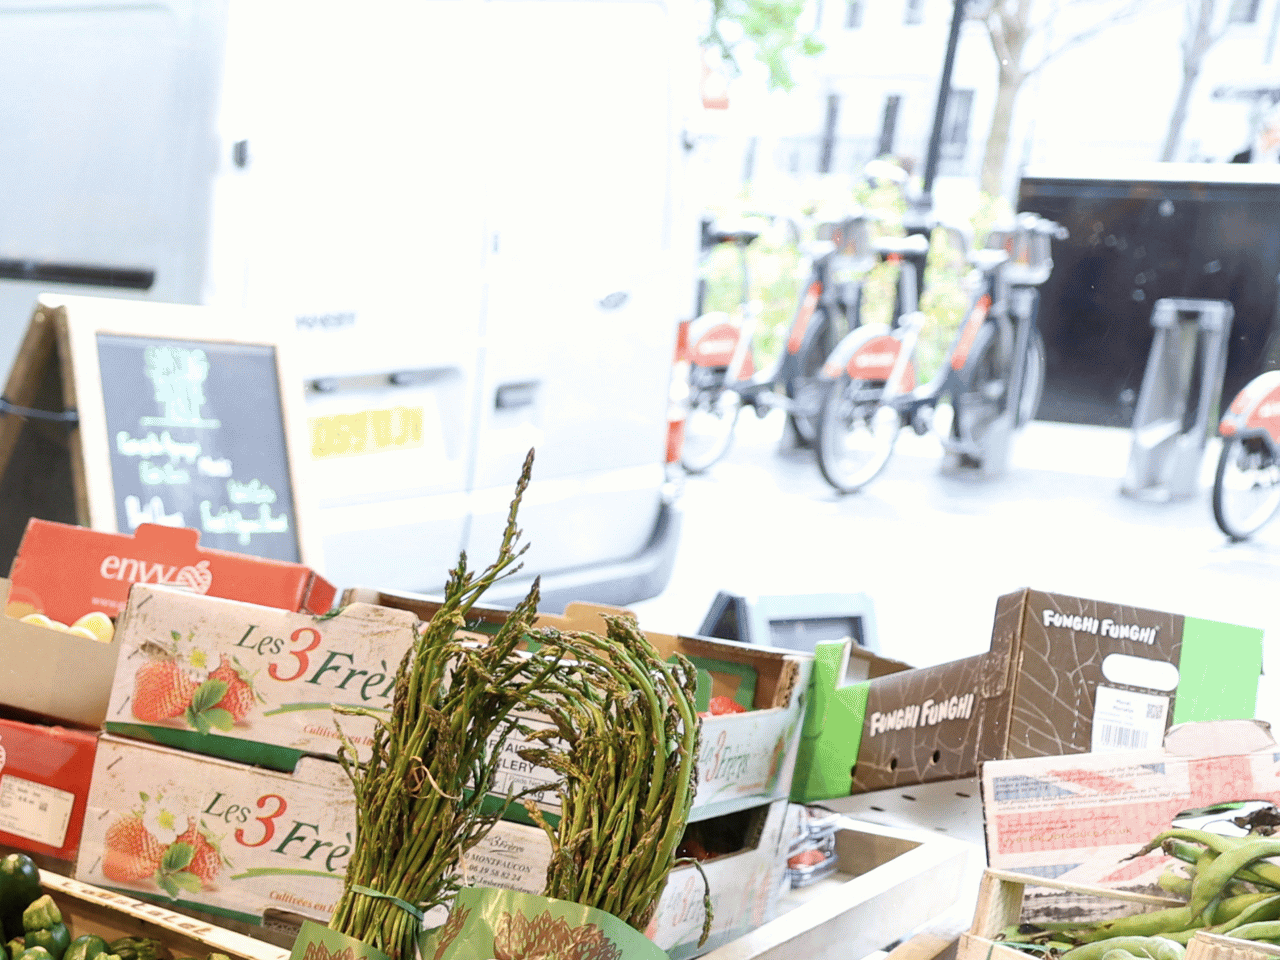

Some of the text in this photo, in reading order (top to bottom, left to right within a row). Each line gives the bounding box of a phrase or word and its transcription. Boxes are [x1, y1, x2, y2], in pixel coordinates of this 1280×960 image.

[1043, 610, 1156, 645] FUNGHI FUNGHI
[233, 624, 285, 656] Les
[267, 626, 322, 682] 3
[869, 694, 974, 737] FUNGHI FUNGHI
[498, 758, 536, 774] LERY
[202, 791, 352, 872] Les 3 Frè
